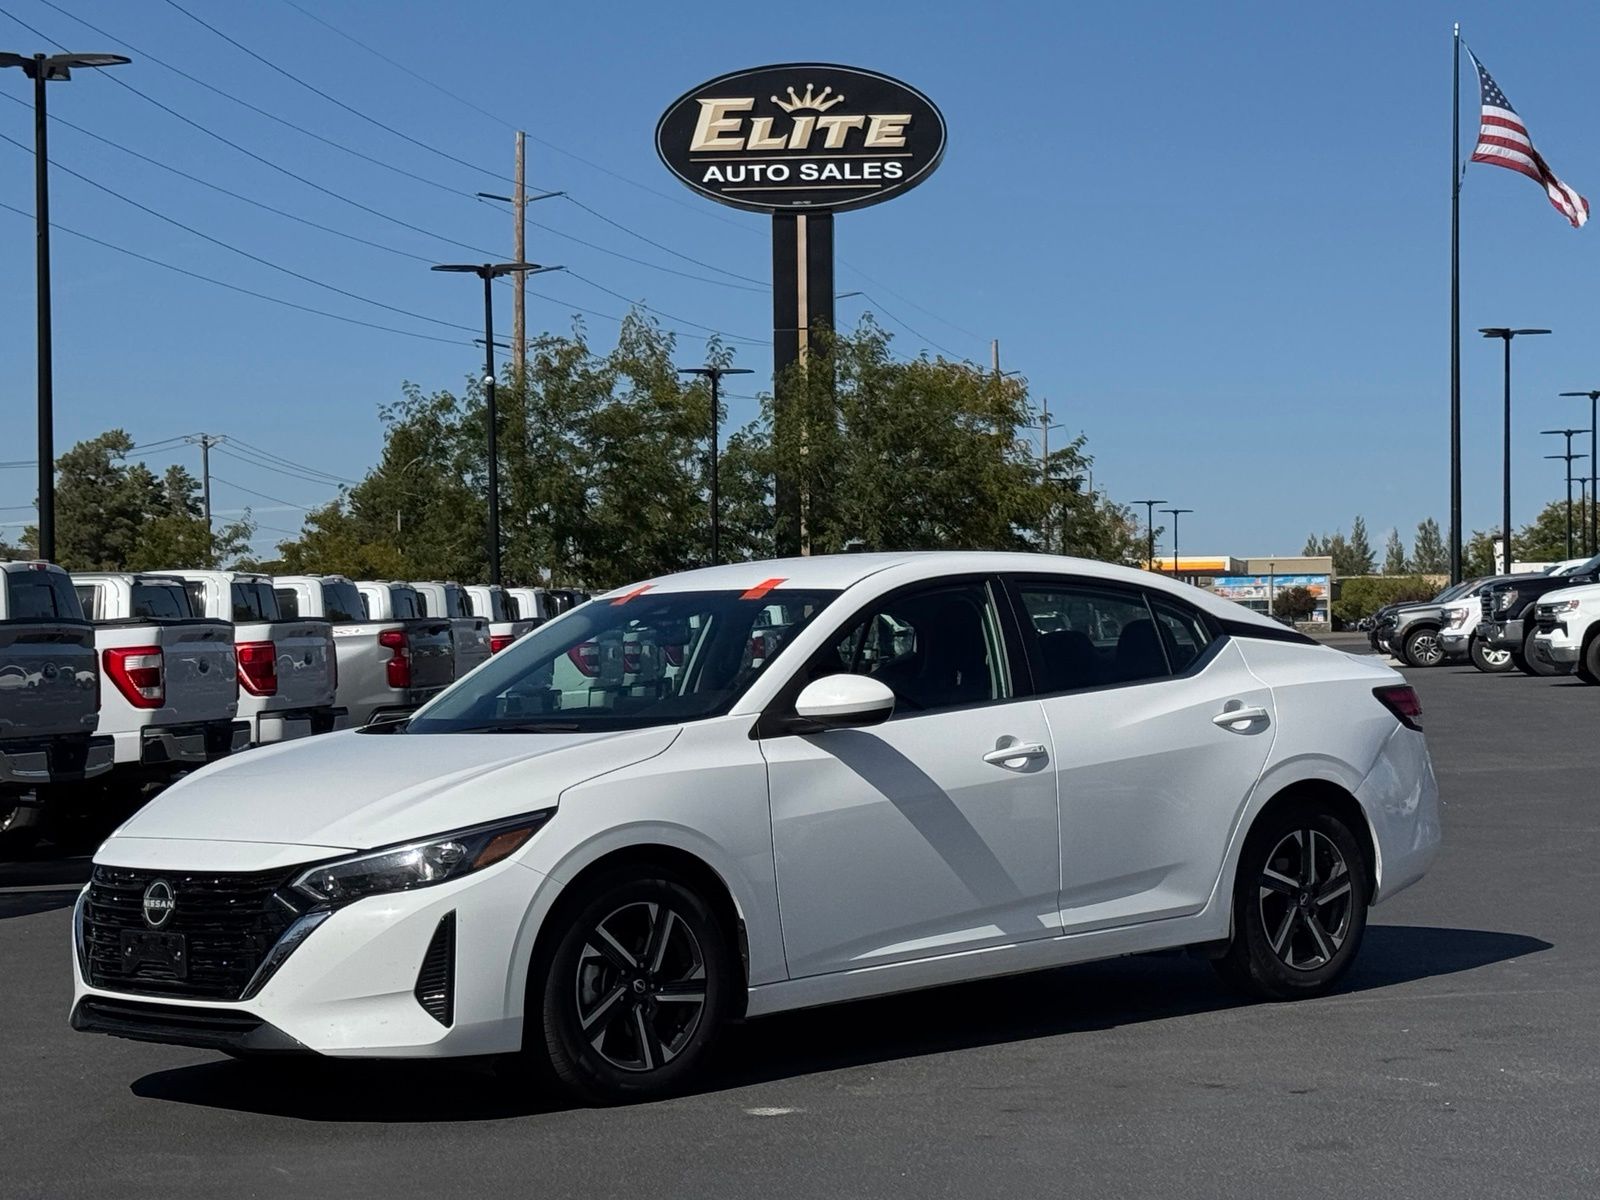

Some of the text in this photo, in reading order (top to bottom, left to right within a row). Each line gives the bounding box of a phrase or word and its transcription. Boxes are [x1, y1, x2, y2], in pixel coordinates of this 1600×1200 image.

[689, 97, 912, 151] ELITE
[702, 161, 903, 183] AUTO SALES
[144, 899, 174, 908] NISSAN
